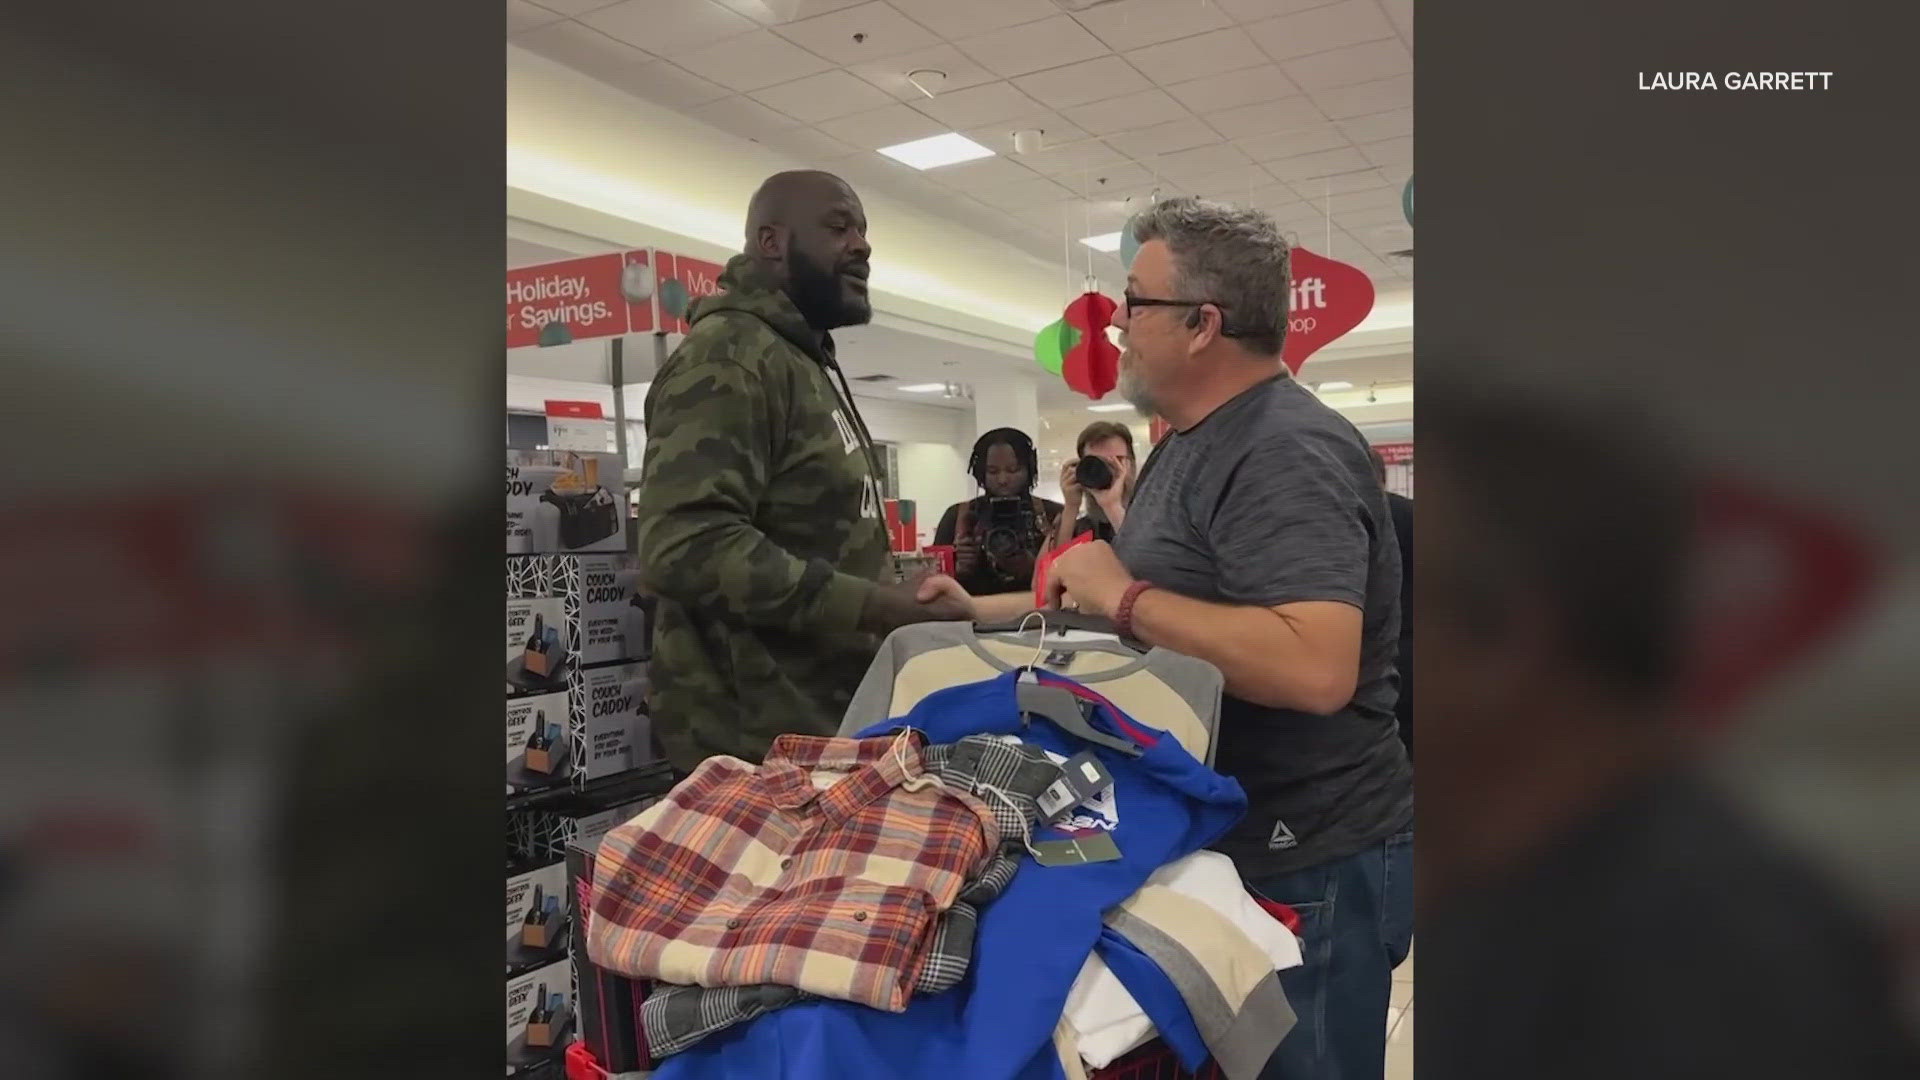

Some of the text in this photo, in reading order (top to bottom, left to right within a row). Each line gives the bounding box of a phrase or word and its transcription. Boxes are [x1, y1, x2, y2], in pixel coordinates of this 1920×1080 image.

[507, 275, 590, 305] Holiday,
[521, 301, 613, 330] Savings.
[587, 573, 615, 587] COUCH
[586, 585, 625, 604] CADDY
[592, 684, 622, 701] COUCH
[592, 696, 632, 718] CADDY
